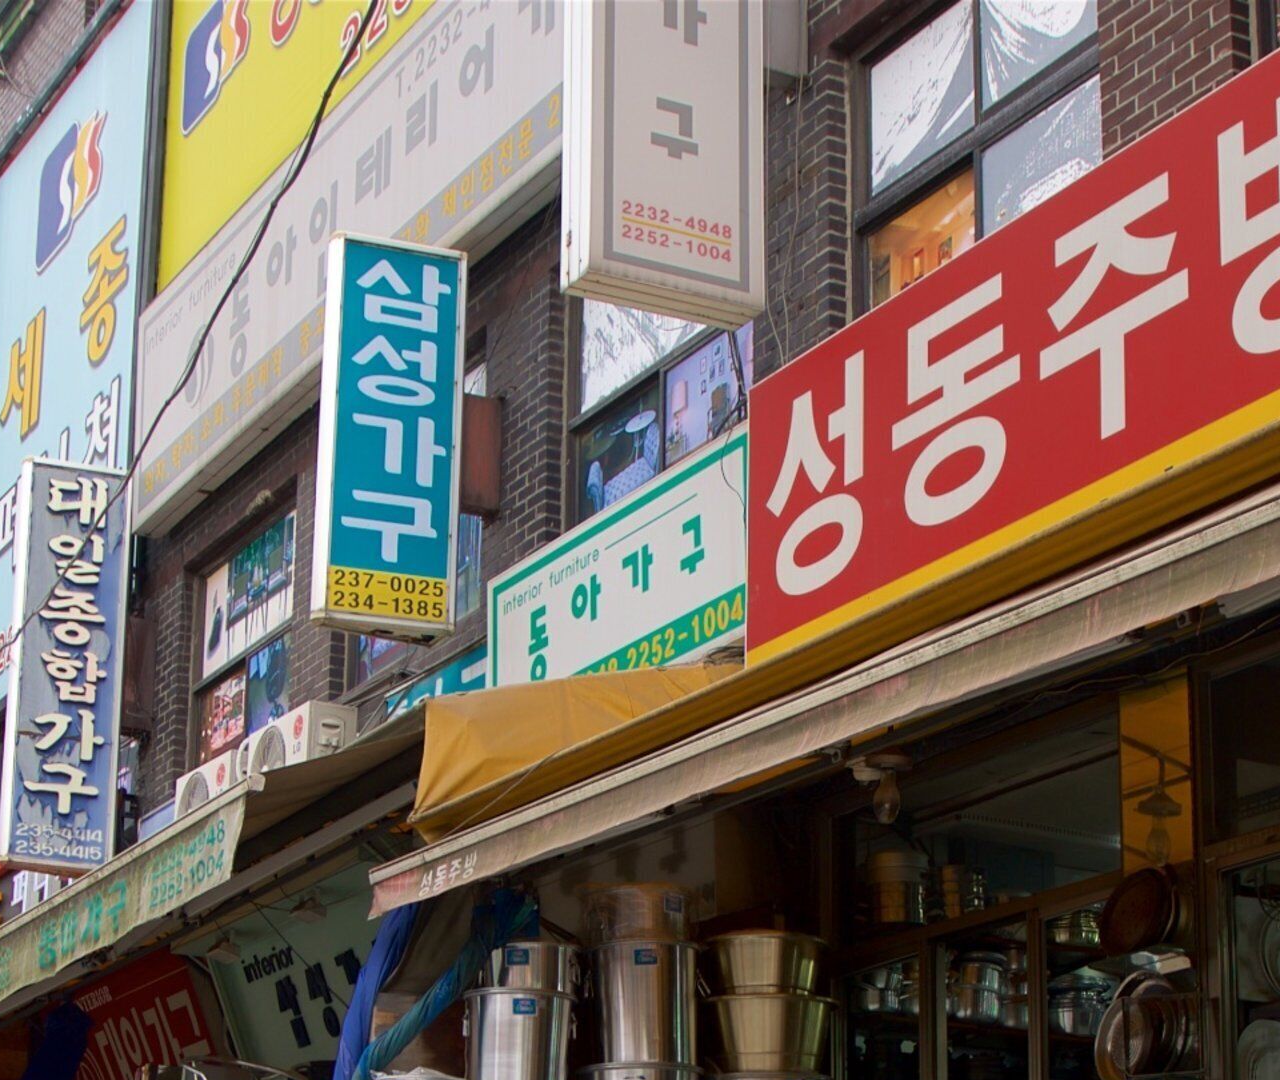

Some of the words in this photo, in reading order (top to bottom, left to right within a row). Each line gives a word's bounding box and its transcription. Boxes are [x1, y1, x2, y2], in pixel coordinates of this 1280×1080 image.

[621, 199, 733, 240] 2232-4948
[621, 224, 733, 263] 2252-1004
[339, 257, 454, 565] 삼성가구
[332, 567, 445, 598] 237-0025
[332, 590, 445, 620] 234-1385
[503, 582, 543, 616] interior
[548, 549, 600, 588] furniture
[528, 513, 705, 682] 동아가구
[23, 475, 109, 815] 대일종합가구
